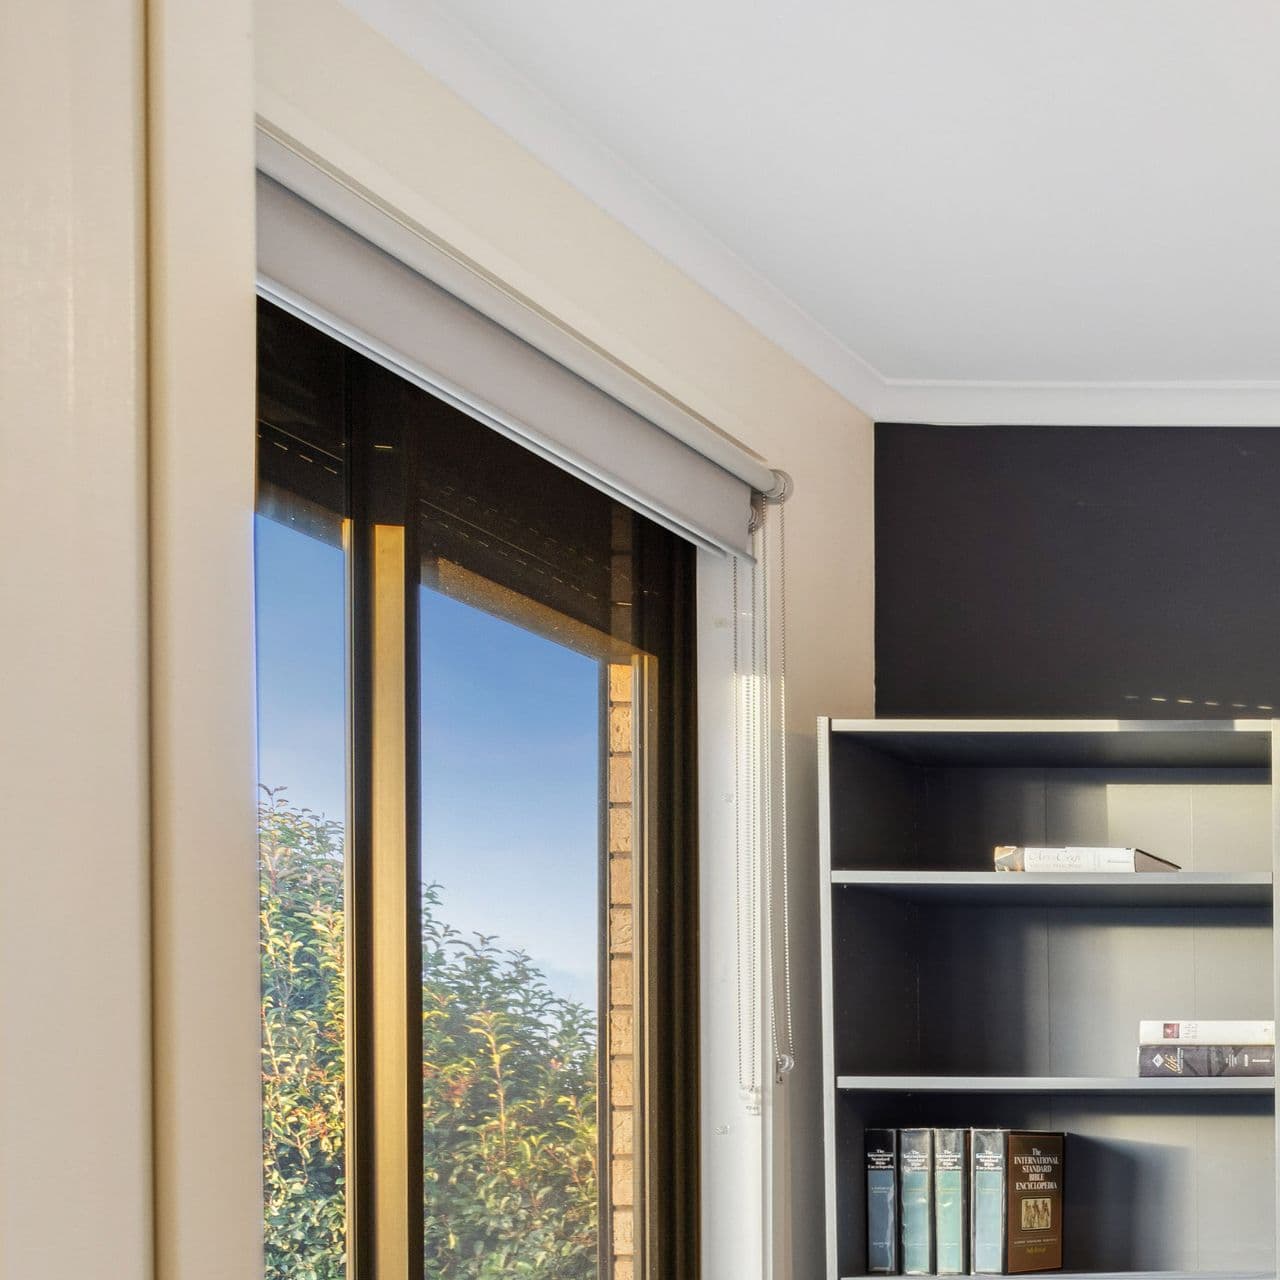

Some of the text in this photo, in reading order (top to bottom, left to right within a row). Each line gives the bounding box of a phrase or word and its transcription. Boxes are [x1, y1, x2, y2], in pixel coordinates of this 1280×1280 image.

[1032, 1148, 1042, 1156] The
[1014, 1156, 1059, 1164] INTERNATIONAL
[1022, 1165, 1052, 1173] STANDARD
[1016, 1182, 1058, 1190] ENCYCLOPEDIA
